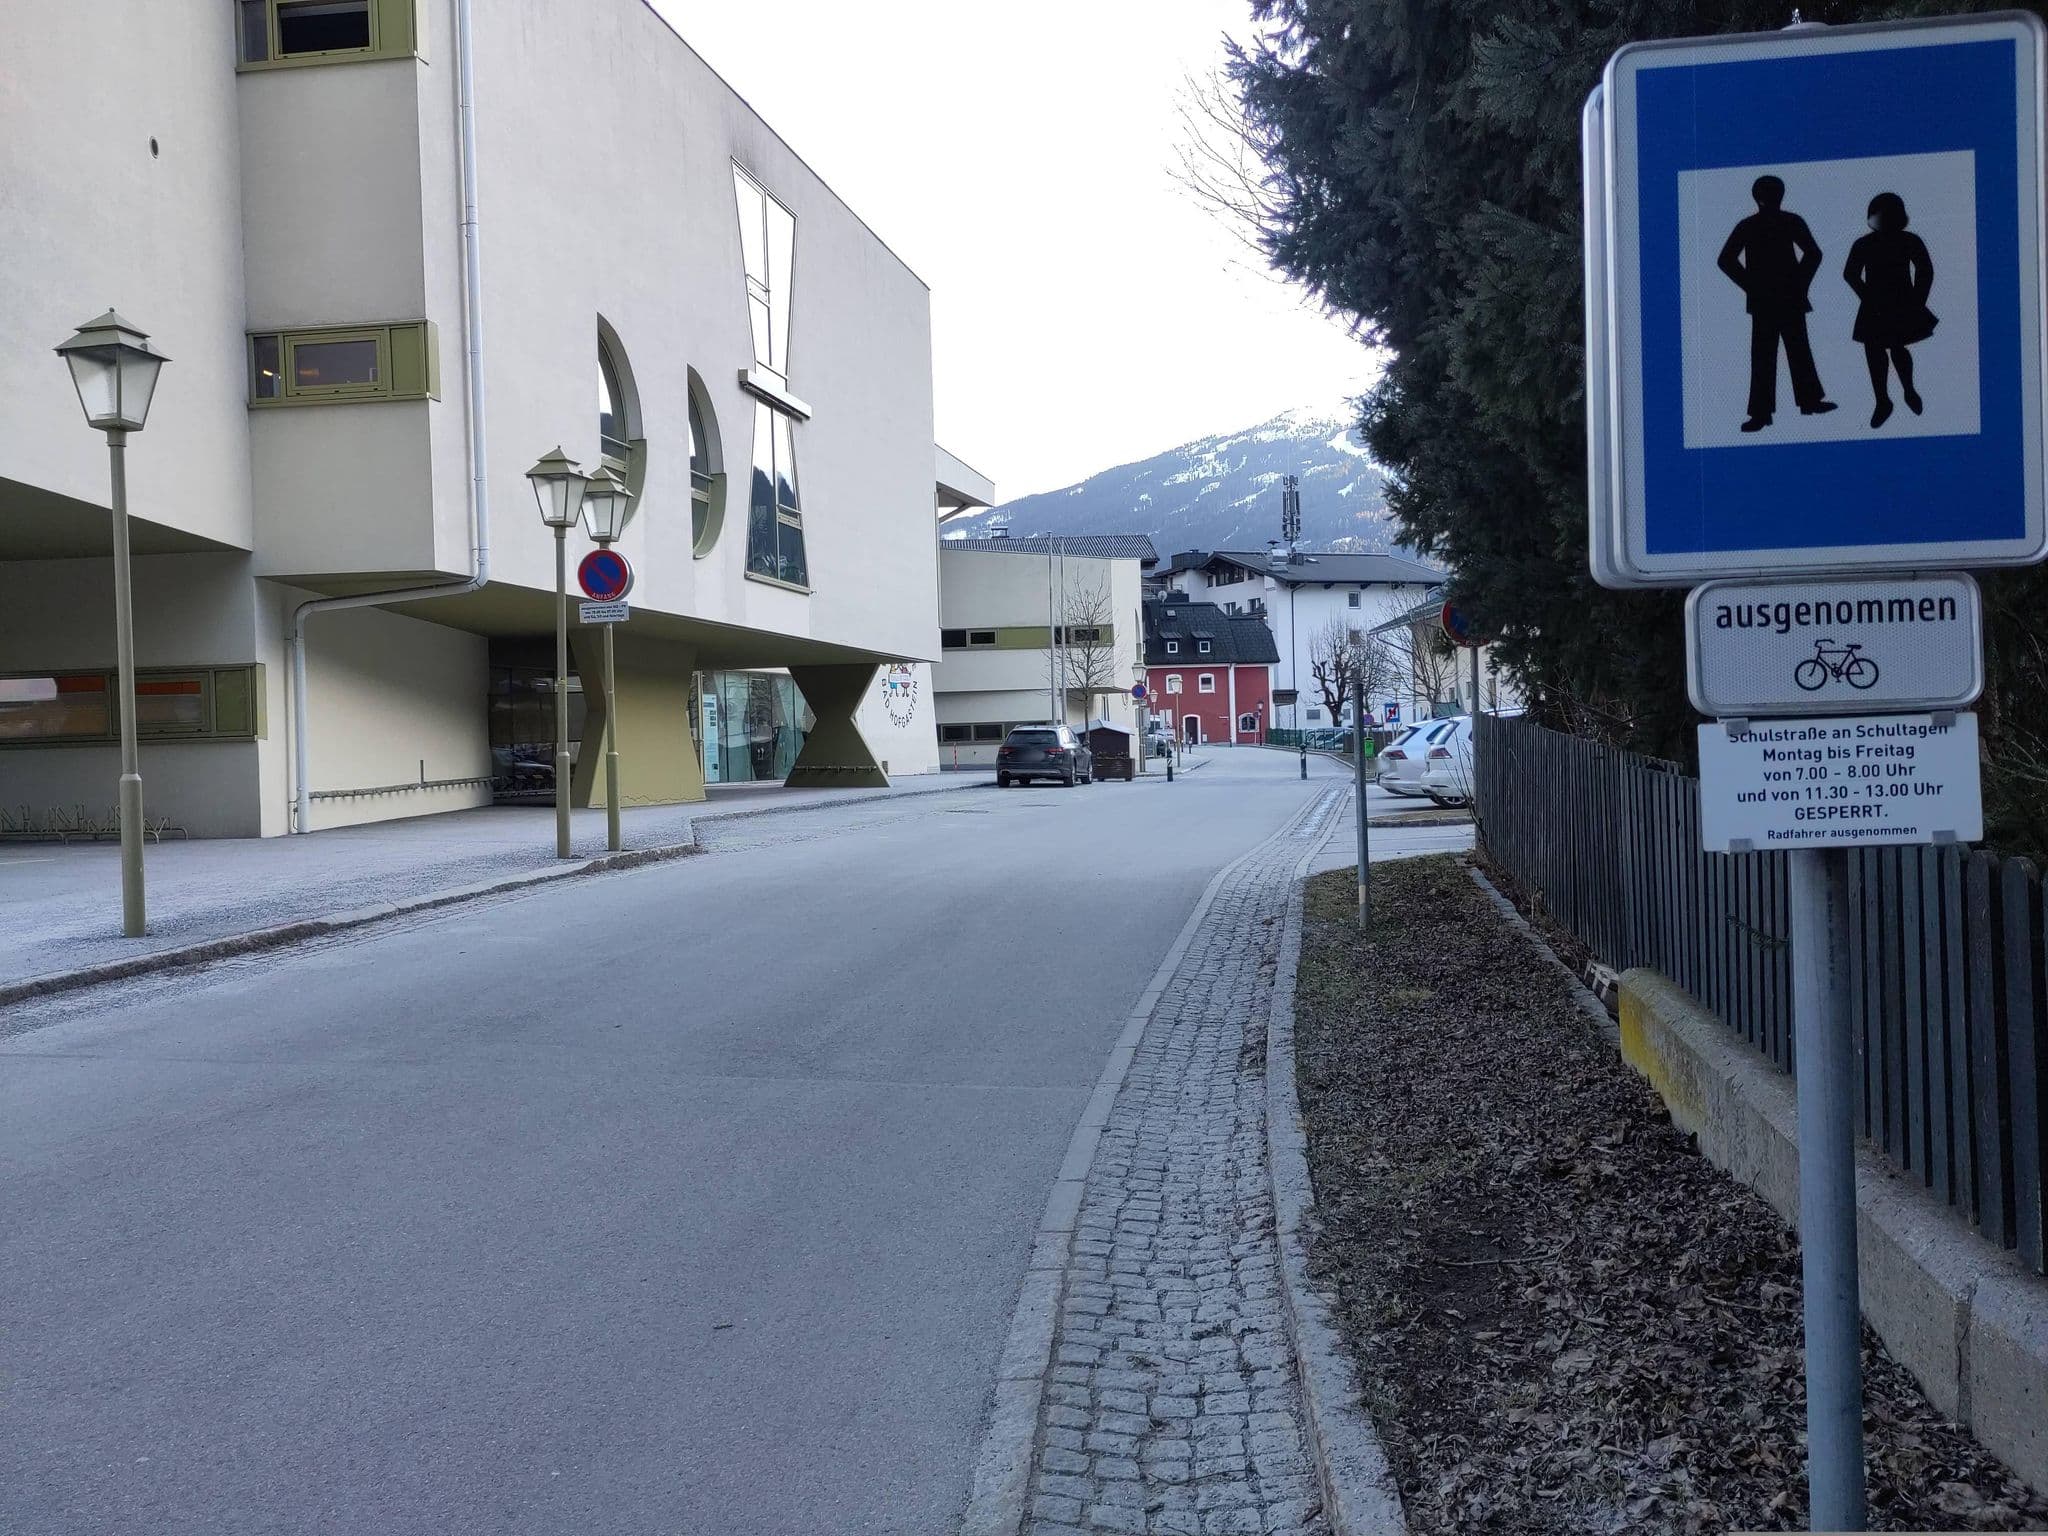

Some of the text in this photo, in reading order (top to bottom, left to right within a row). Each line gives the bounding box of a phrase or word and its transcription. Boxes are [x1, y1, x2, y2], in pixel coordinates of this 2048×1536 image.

[1715, 595, 1957, 634] ausgenommen
[1729, 723, 1948, 743] Schulstraße an Schultagen
[1763, 744, 1915, 763] Montag bis Freitag
[1763, 770, 1792, 782] von
[1796, 766, 1828, 781] 7.00
[1847, 764, 1880, 778] 8.00
[1886, 763, 1916, 777] Uhr
[1737, 788, 1767, 803] und
[1771, 790, 1800, 801] von
[1805, 785, 1848, 800] 11.30
[1865, 783, 1909, 798] 13.00
[1914, 782, 1944, 796] Uhr
[1794, 804, 1889, 821] GESPERRT.
[1767, 826, 1918, 840] Radfahrer ausgenommen
